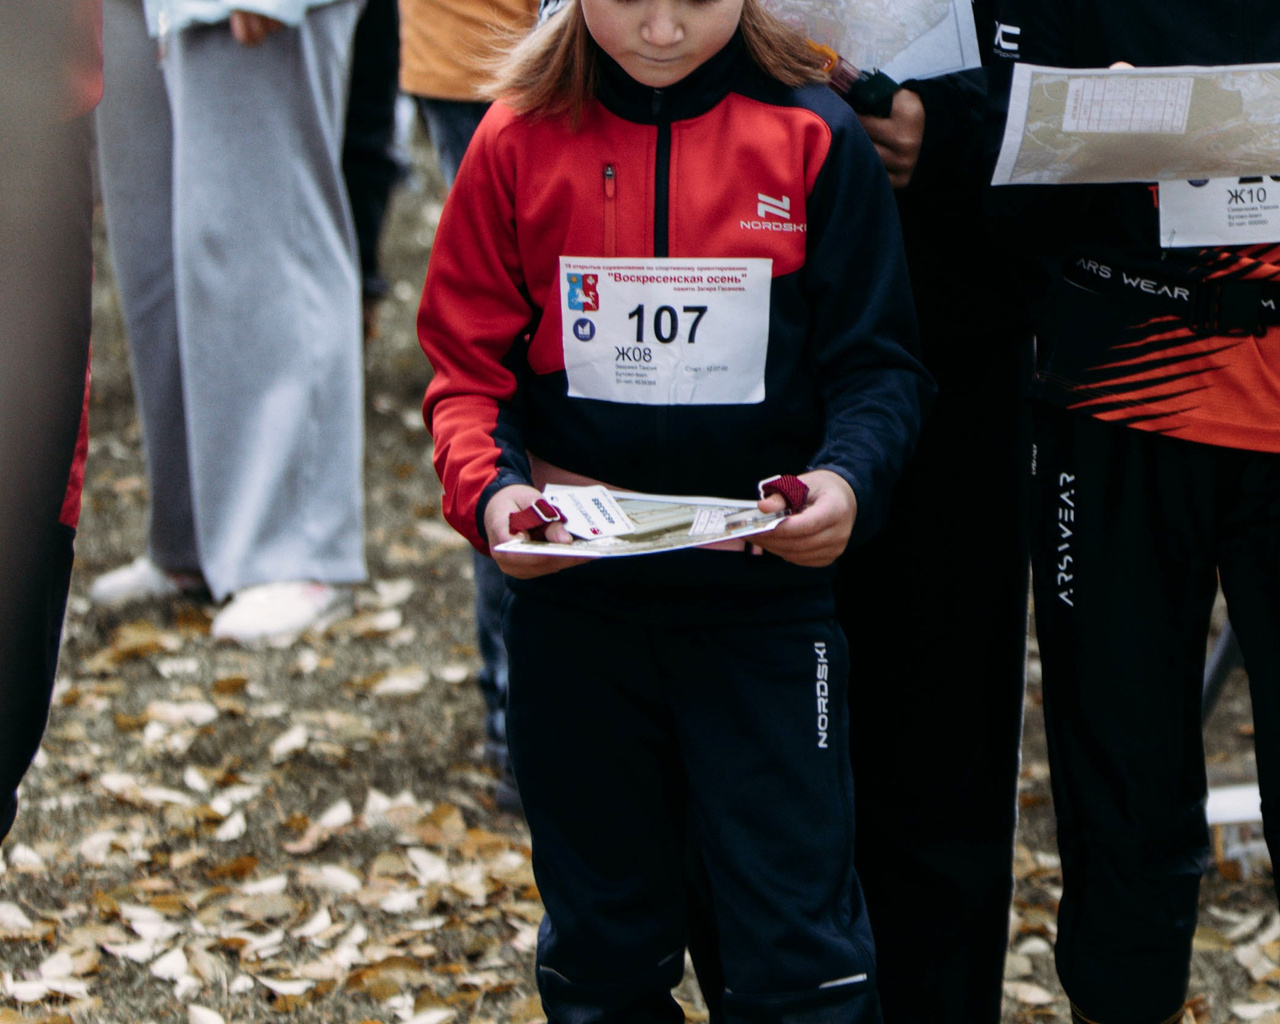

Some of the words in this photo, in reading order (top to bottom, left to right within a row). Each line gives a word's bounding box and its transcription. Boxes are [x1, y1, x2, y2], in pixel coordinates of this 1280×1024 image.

[1227, 187, 1267, 204] Ж10
[608, 272, 703, 285] "Воскресенская
[707, 273, 747, 284] осень"
[1122, 272, 1190, 301] WEAR
[628, 304, 708, 344] 107
[615, 346, 652, 363] Ж08
[813, 641, 829, 748] NORDSKI
